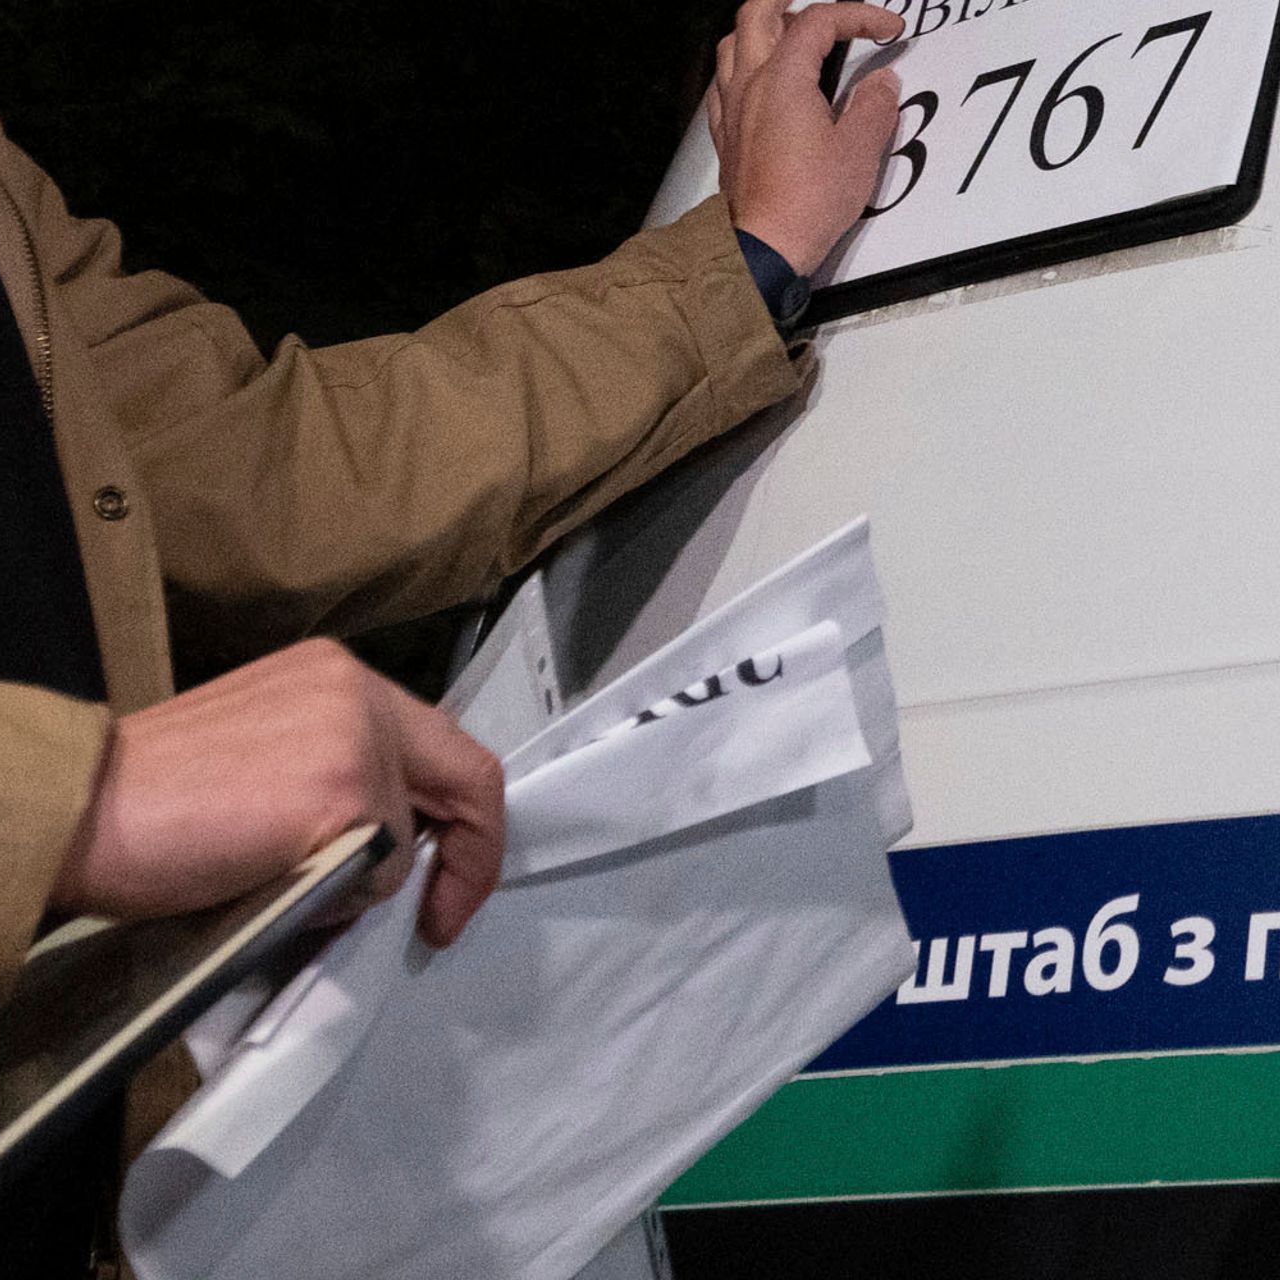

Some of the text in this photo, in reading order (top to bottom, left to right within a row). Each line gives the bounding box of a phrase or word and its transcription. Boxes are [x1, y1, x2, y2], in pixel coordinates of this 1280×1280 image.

[863, 10, 1213, 219] 3767
[895, 892, 1141, 1005] штаб
[1163, 915, 1216, 986] з
